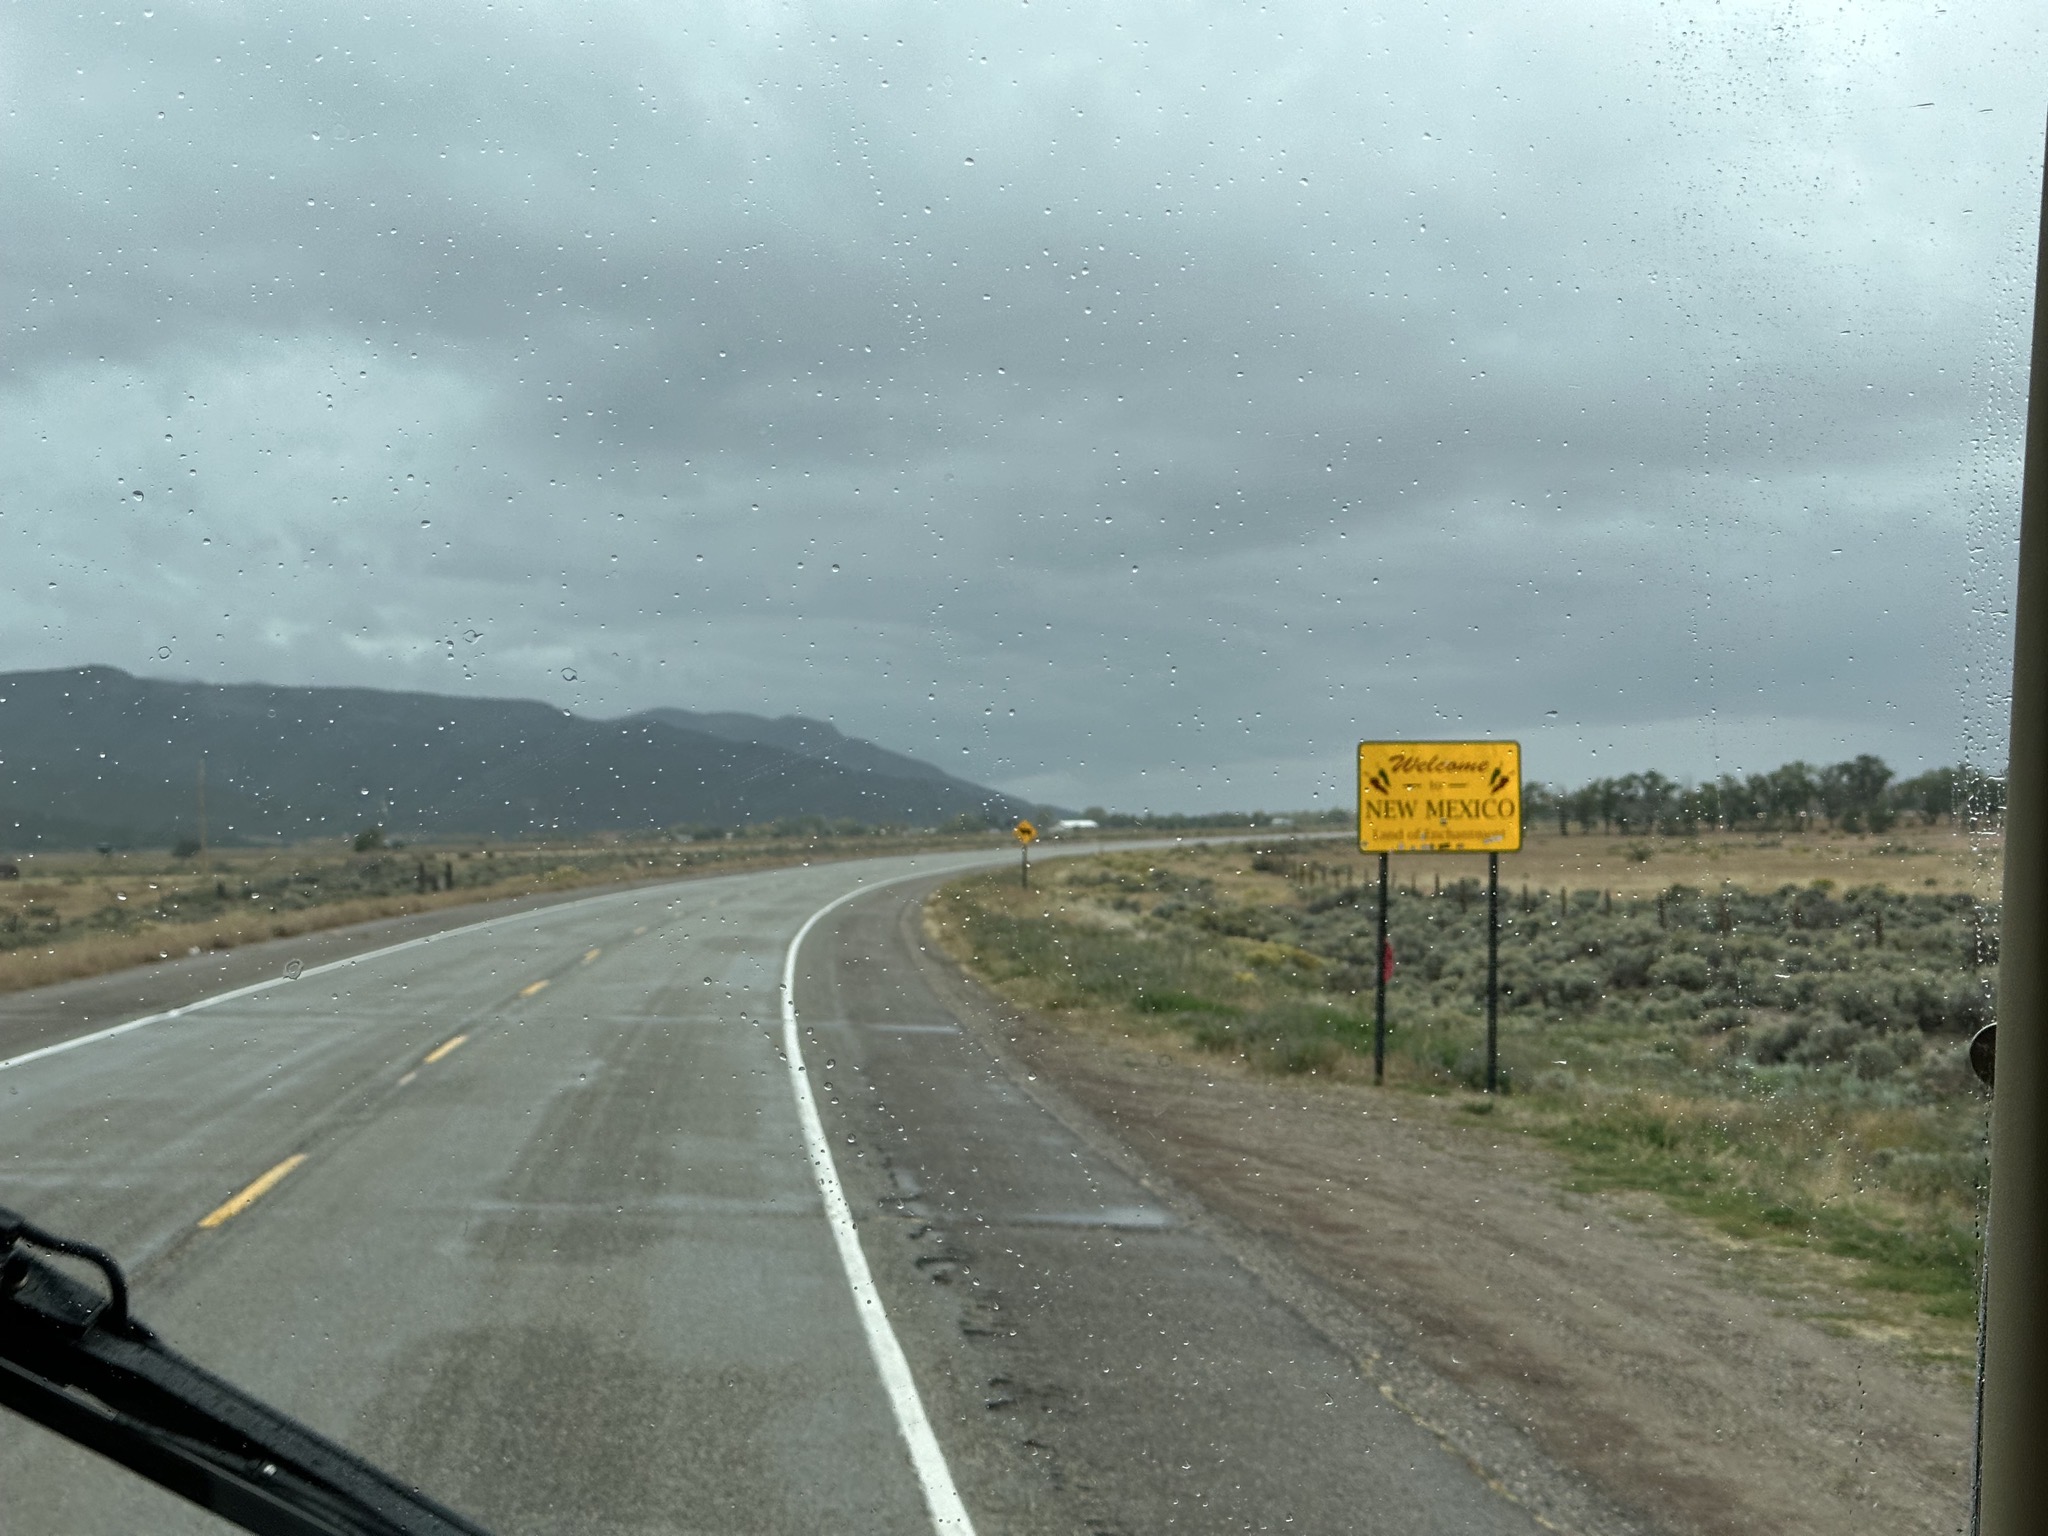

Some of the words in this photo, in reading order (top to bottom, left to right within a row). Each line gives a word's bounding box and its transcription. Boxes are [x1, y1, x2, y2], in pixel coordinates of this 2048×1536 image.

[1388, 754, 1489, 773] Welcome
[1366, 799, 1418, 819] NEW
[1425, 799, 1515, 819] MEXICO
